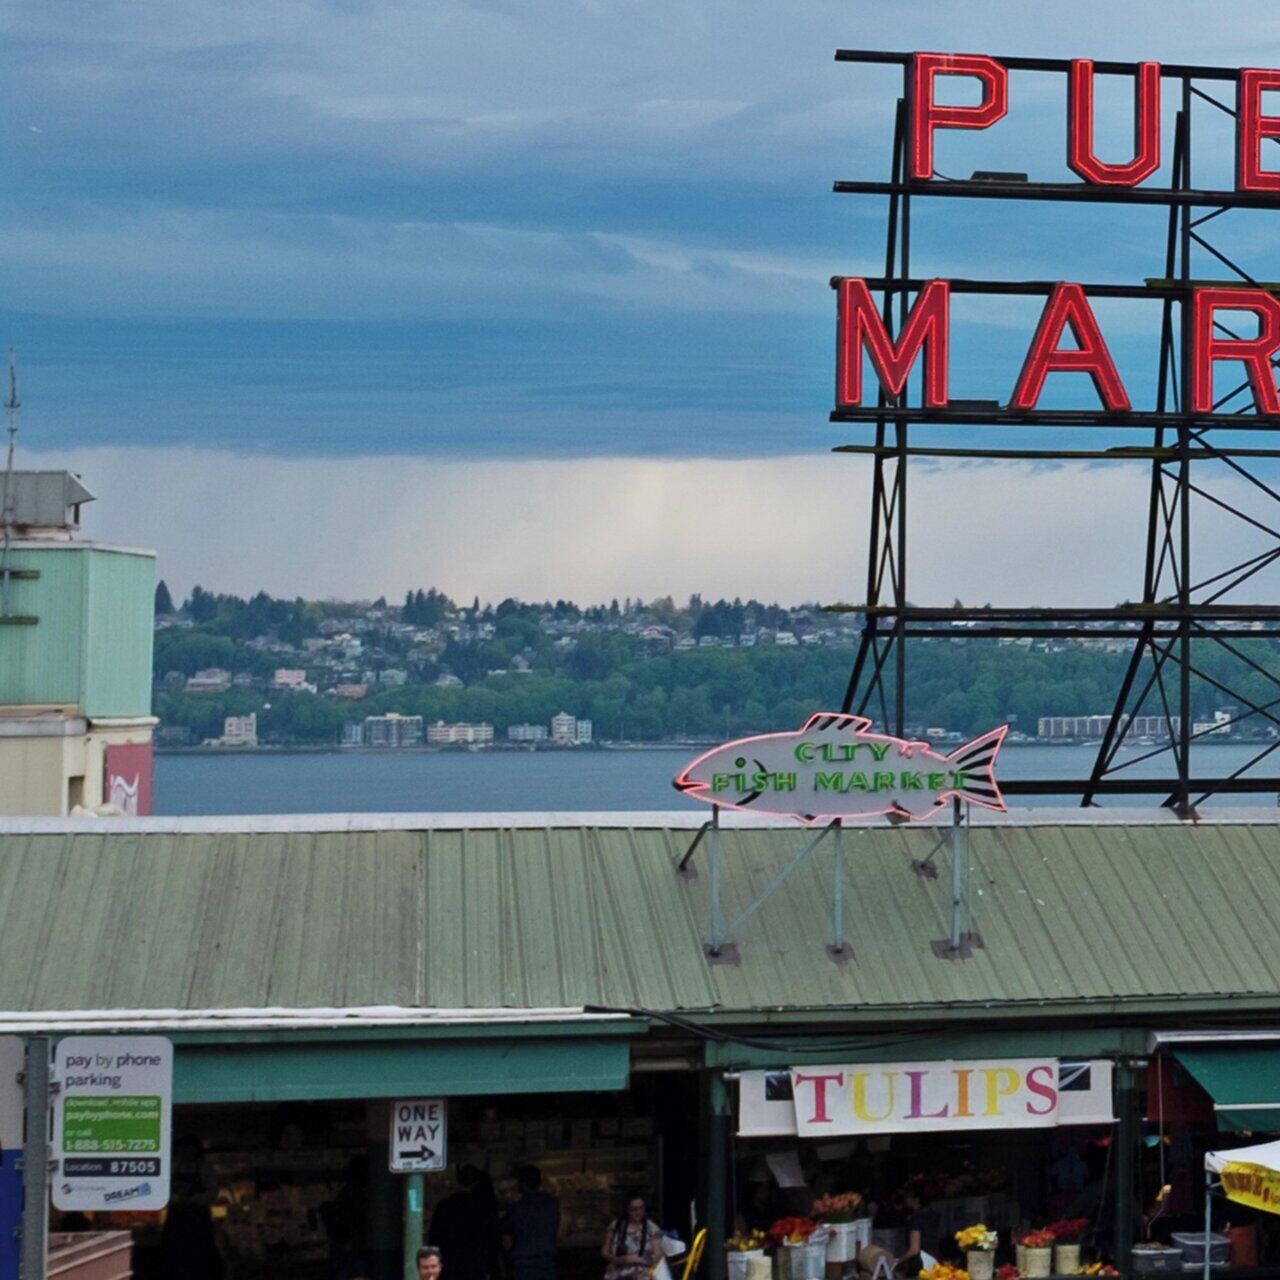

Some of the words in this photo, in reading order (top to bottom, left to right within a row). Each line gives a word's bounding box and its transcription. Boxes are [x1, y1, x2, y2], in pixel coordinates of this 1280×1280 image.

[794, 741, 892, 763] CITY
[712, 771, 797, 793] FISH
[815, 771, 970, 794] MARKET
[66, 1055, 92, 1070] pay
[95, 1053, 114, 1069] by
[116, 1053, 160, 1067] phone
[65, 1073, 122, 1089] parking
[794, 1065, 1059, 1124] TULIPS
[65, 1110, 160, 1122] paybyphone.com
[398, 1105, 440, 1122] ONE
[397, 1124, 440, 1142] WAY
[110, 1160, 157, 1173] 87505
